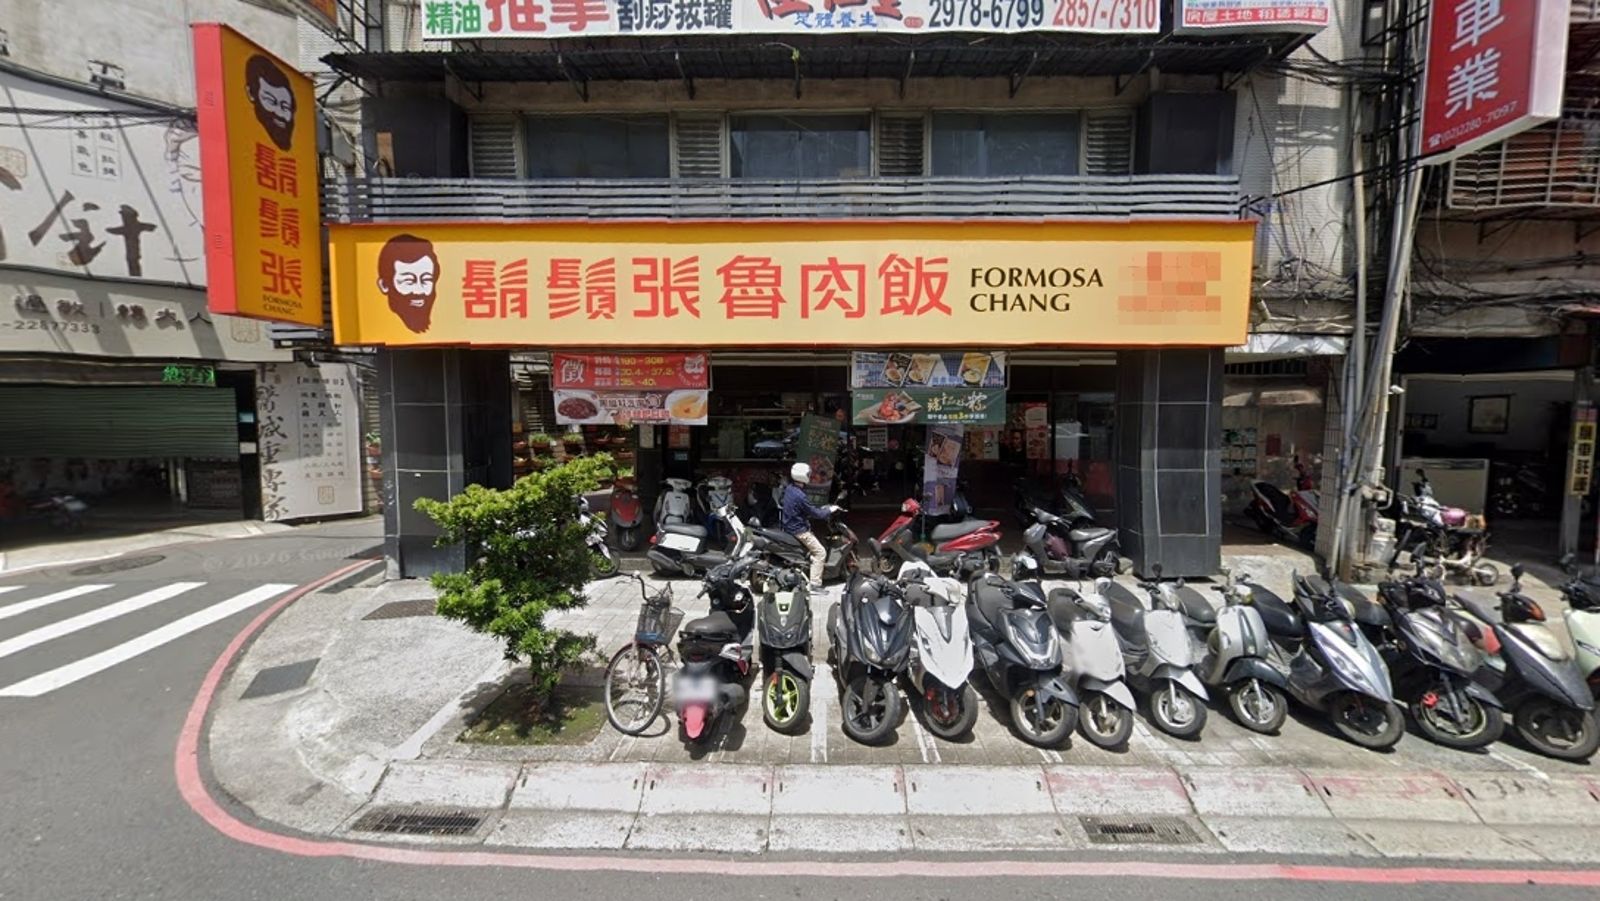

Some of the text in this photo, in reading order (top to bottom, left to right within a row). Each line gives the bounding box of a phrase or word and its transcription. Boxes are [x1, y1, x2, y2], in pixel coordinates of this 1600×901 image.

[426, 1, 481, 34] 精油
[617, 0, 733, 31] 刮痧拔罐
[928, 0, 1044, 28] 2978-6799
[1053, 0, 1157, 28] 2857-7310
[1445, 0, 1504, 119] 車業
[255, 142, 303, 298] 鬍鬚張
[462, 253, 952, 320] 鬍鬚張魯肉飯
[970, 267, 1104, 287] FORMOSA
[262, 303, 296, 316] CHANG
[969, 293, 1071, 312] CHANG
